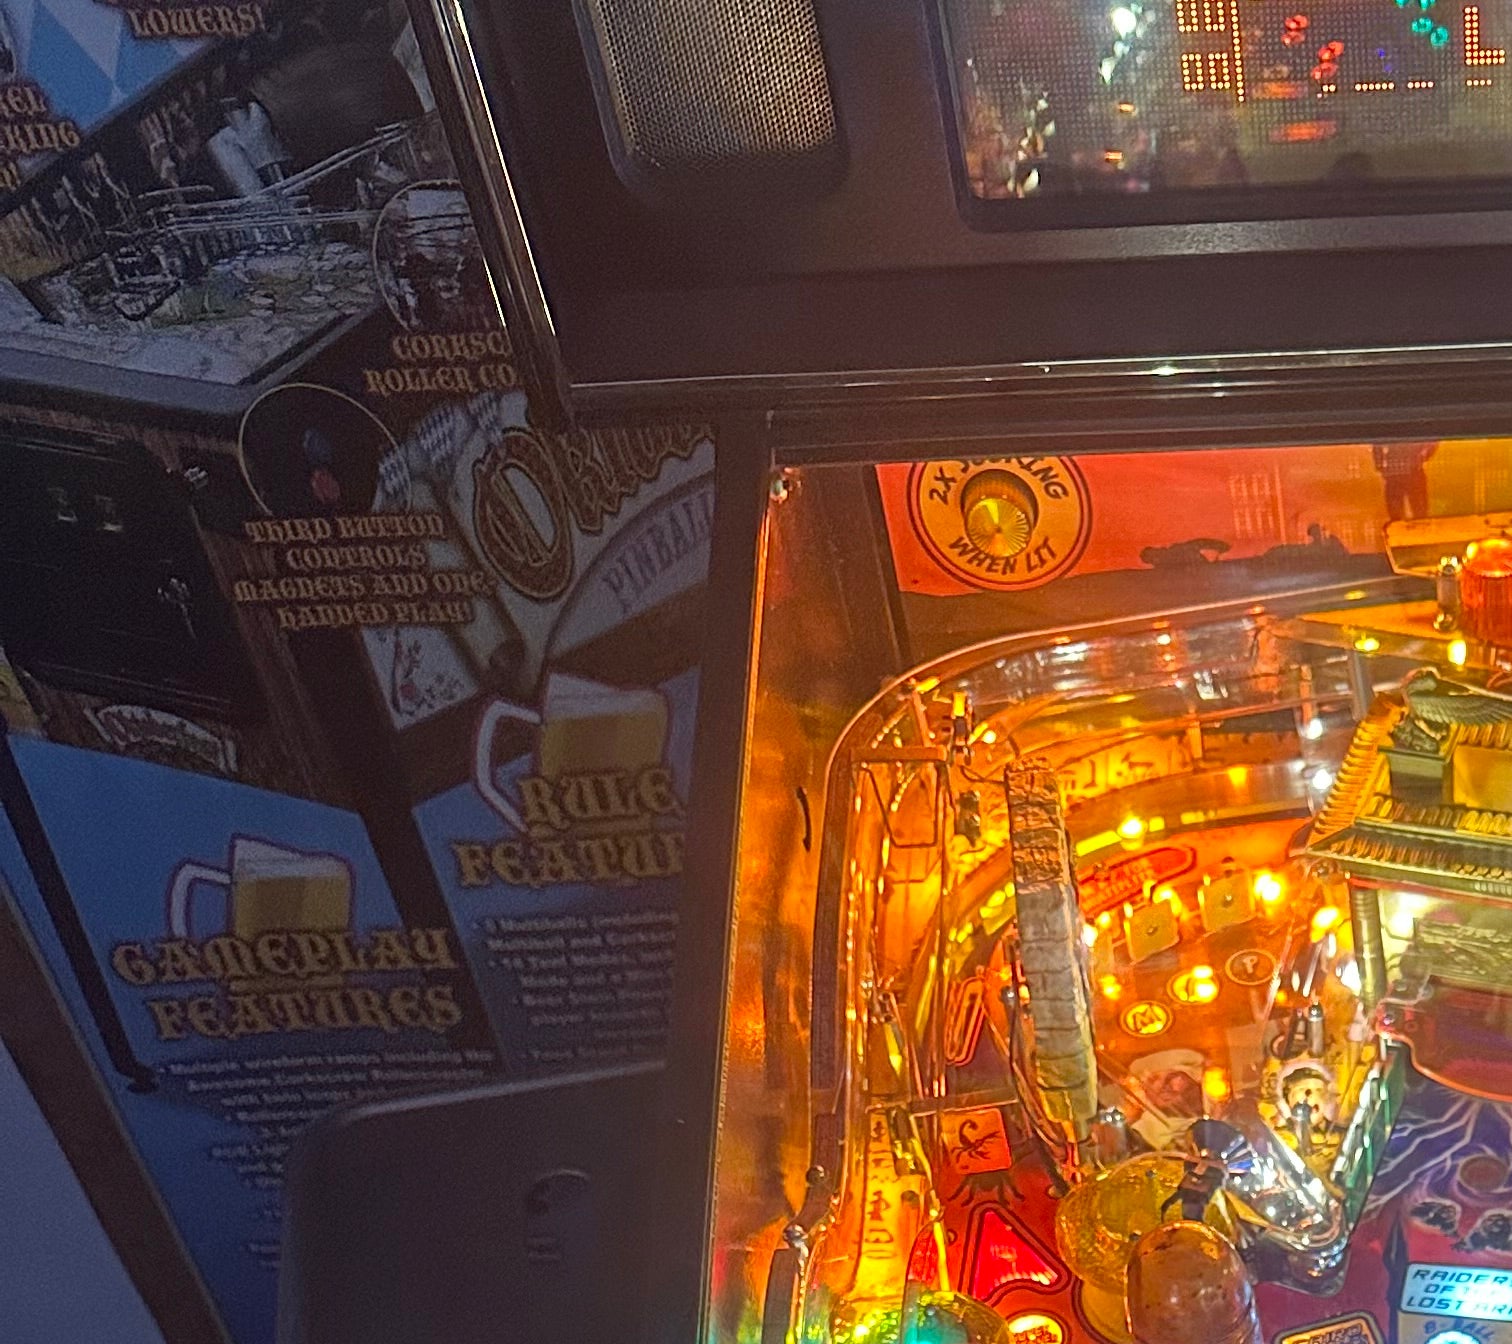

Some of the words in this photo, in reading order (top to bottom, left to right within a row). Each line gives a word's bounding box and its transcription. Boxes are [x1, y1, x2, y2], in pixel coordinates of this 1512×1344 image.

[363, 364, 473, 397] ROLLER
[929, 467, 958, 506] 2X
[244, 517, 331, 545] THIRD
[336, 512, 445, 540] BUTTON
[286, 542, 427, 570] CONTROLS
[949, 537, 1017, 575] WHEN
[1026, 536, 1058, 573] LIT
[233, 578, 366, 602] MAGNETS
[370, 573, 429, 598] AND
[278, 604, 391, 630] HANDED
[517, 768, 676, 830] RULE
[453, 832, 685, 889] FEATUR
[111, 926, 459, 986] GAMEPLAY
[148, 983, 464, 1042] FEATURES
[1406, 1298, 1462, 1311] LOST
[1424, 1283, 1455, 1294] OF
